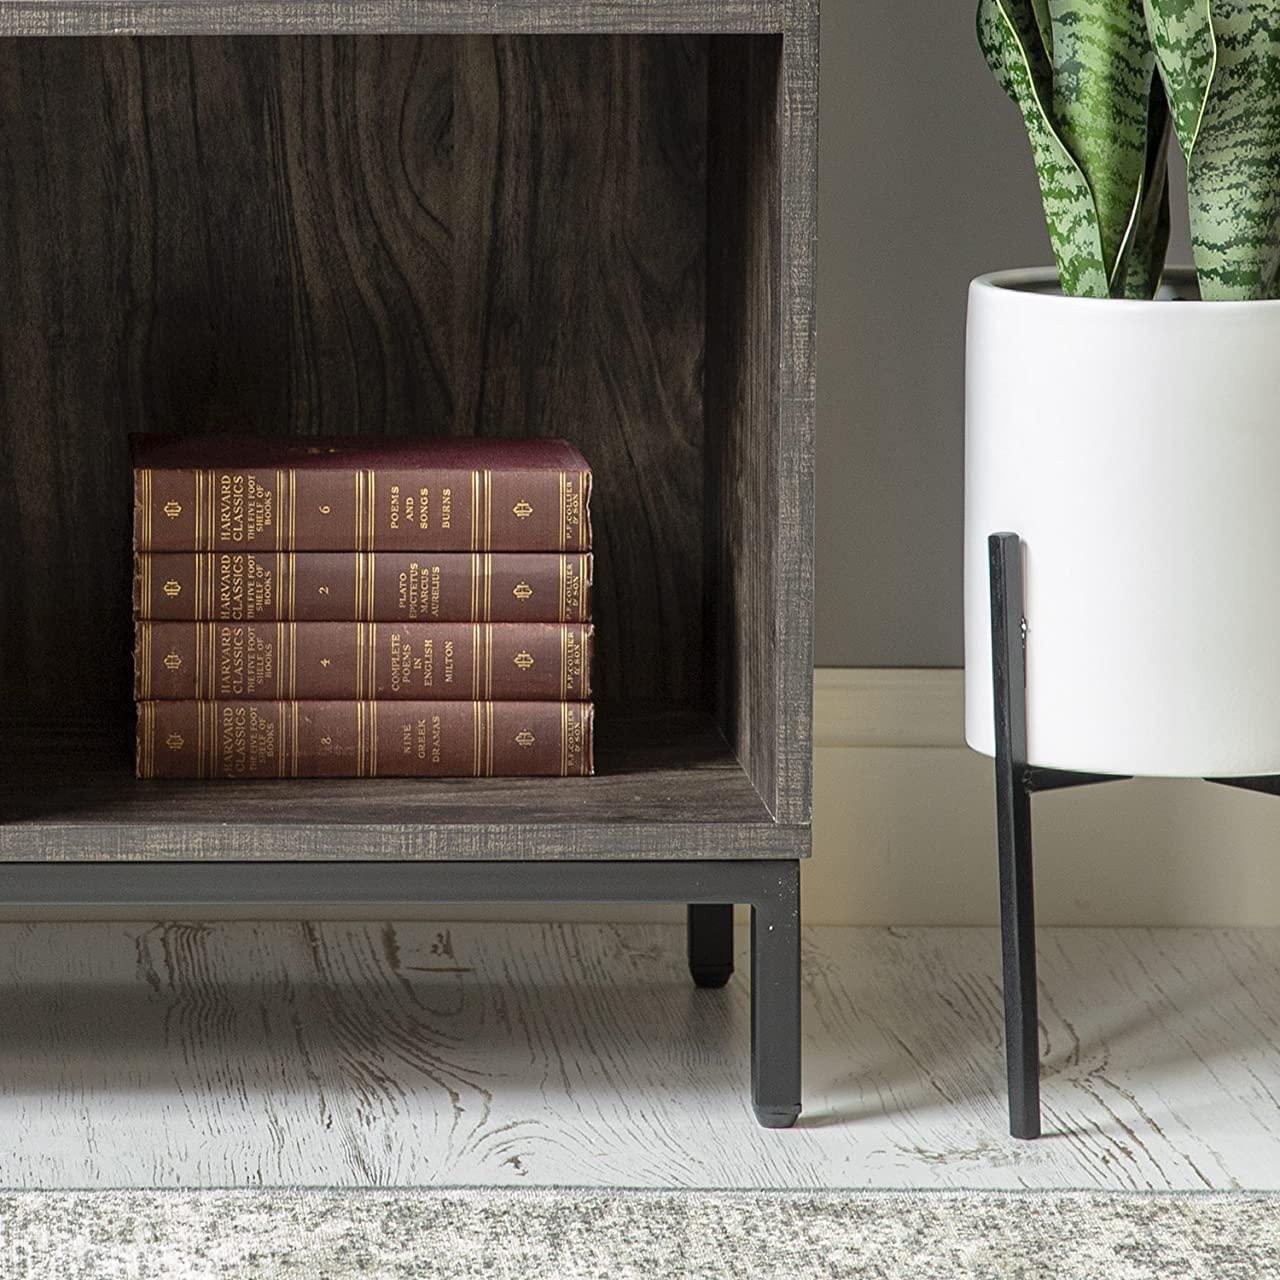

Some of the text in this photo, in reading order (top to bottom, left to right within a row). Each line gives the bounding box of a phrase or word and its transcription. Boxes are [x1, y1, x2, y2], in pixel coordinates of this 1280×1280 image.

[221, 475, 231, 540] HARVARD
[233, 475, 244, 542] CLASSICS
[248, 476, 256, 499] FOOT
[256, 484, 264, 532] SHELF OF
[391, 486, 400, 529] POEMS
[406, 496, 414, 522] AND
[420, 488, 429, 529] SONGS
[442, 488, 451, 528] BURNS
[319, 506, 330, 514] 6
[220, 554, 230, 620] HARVARD
[232, 556, 244, 620] CLASSICS
[256, 564, 264, 612] SHELF OF
[264, 571, 272, 606] BOOKS
[318, 586, 328, 595] 2
[399, 572, 407, 608] PLATO
[409, 563, 418, 619] EPICTETUS
[421, 568, 429, 613] MARCUS
[432, 566, 440, 616] AURELIUS
[221, 627, 231, 693] HARVARD
[233, 628, 244, 694] CLASSICS
[257, 638, 264, 650] OF
[320, 658, 331, 668] 4
[392, 634, 400, 691] COMPLETE
[403, 644, 412, 683] POEMS
[414, 657, 422, 670] IN
[424, 639, 432, 686] ENGLISH
[445, 640, 454, 683] MILTON
[404, 724, 412, 754] NINE
[418, 719, 426, 758] GREEK
[432, 716, 440, 762] DRAMAS
